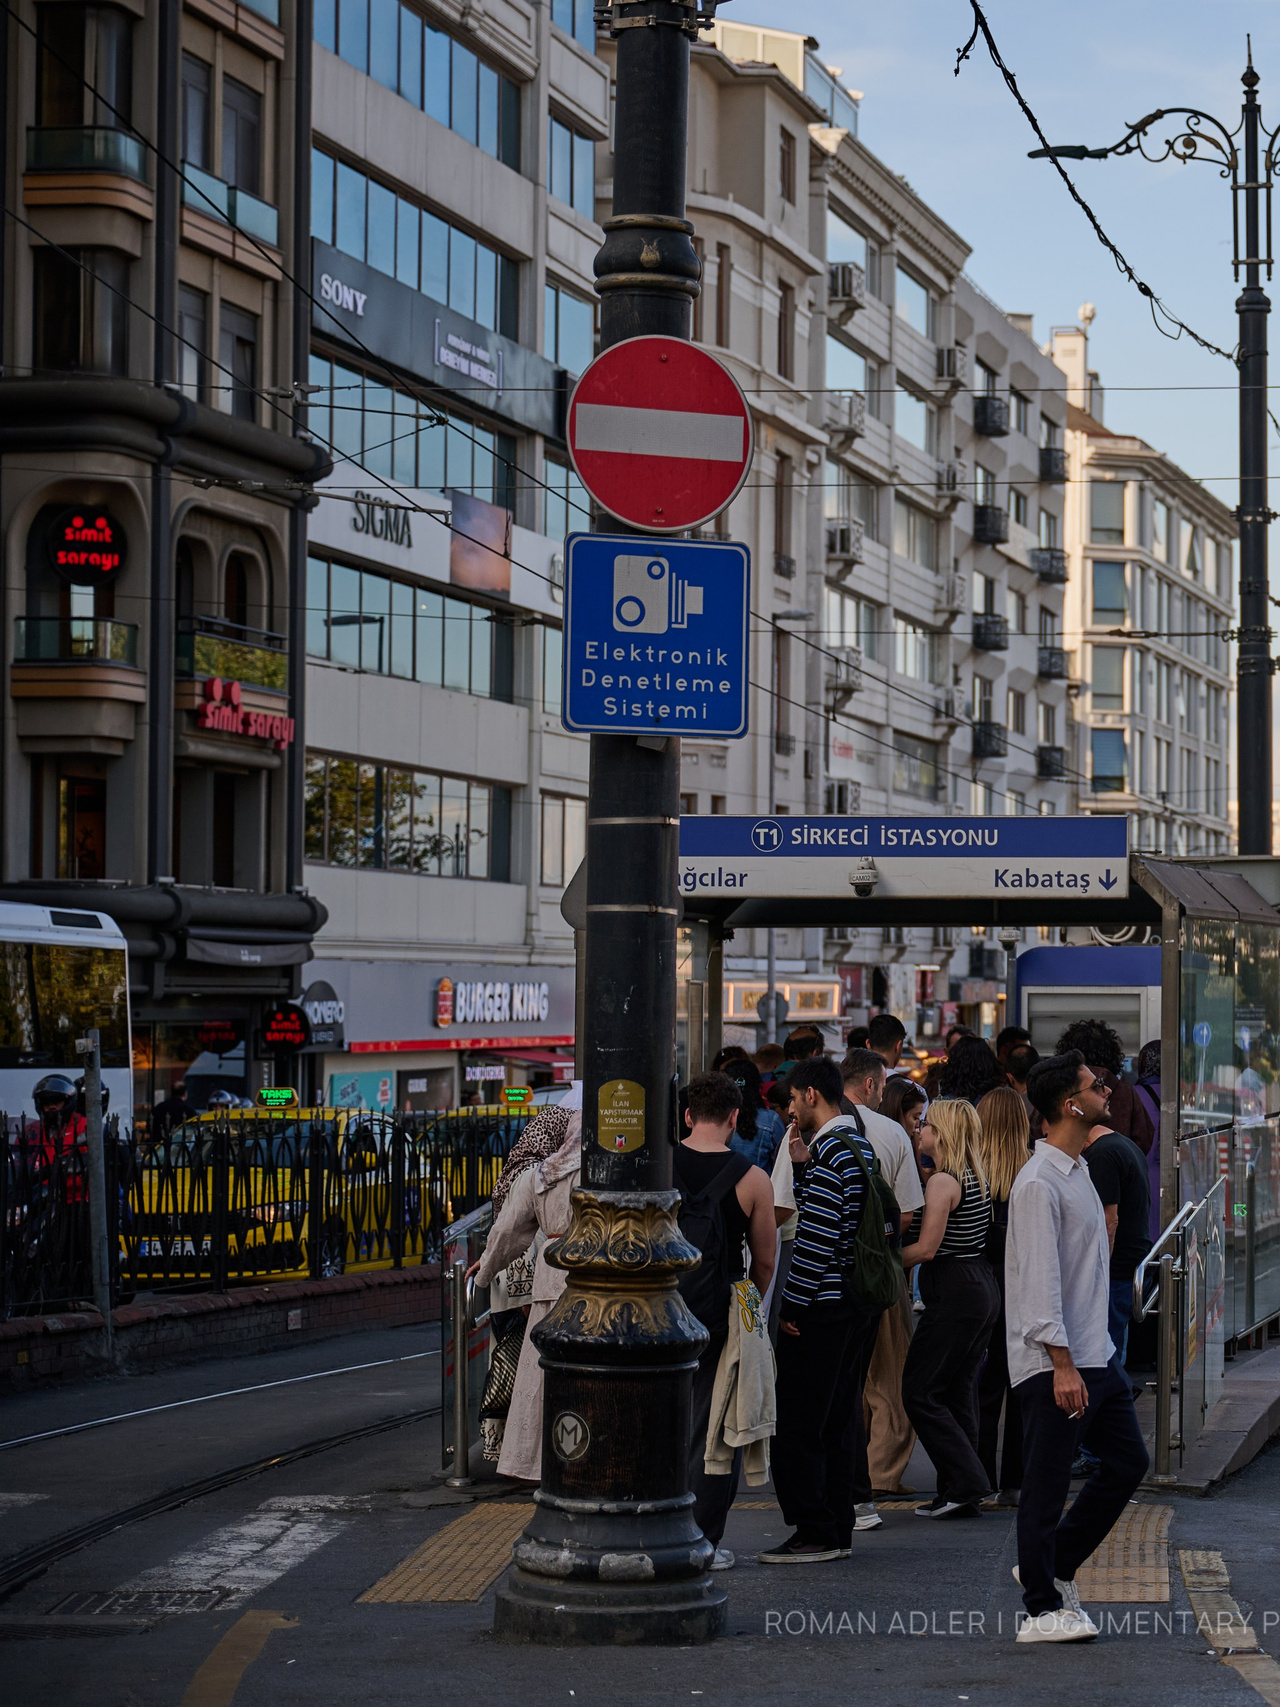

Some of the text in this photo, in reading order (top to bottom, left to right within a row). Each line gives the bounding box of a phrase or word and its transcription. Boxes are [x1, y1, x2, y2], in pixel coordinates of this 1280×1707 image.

[320, 273, 368, 317] SONY
[64, 515, 113, 543] simit
[352, 490, 412, 549] SIGMA
[56, 549, 120, 572] sarayı
[585, 641, 729, 666] Elektronik
[581, 668, 732, 694] Denetleme
[603, 697, 708, 720] Sistemi
[755, 824, 999, 847] T1 SİRKECİ İSTASYONU
[851, 874, 871, 883] CAM02
[994, 868, 1091, 894] Kabataş
[455, 982, 511, 1023] BURGER
[512, 982, 549, 1022] KING
[599, 1109, 644, 1117] YAPIŞTIRMAK
[612, 1099, 630, 1107] İLAN
